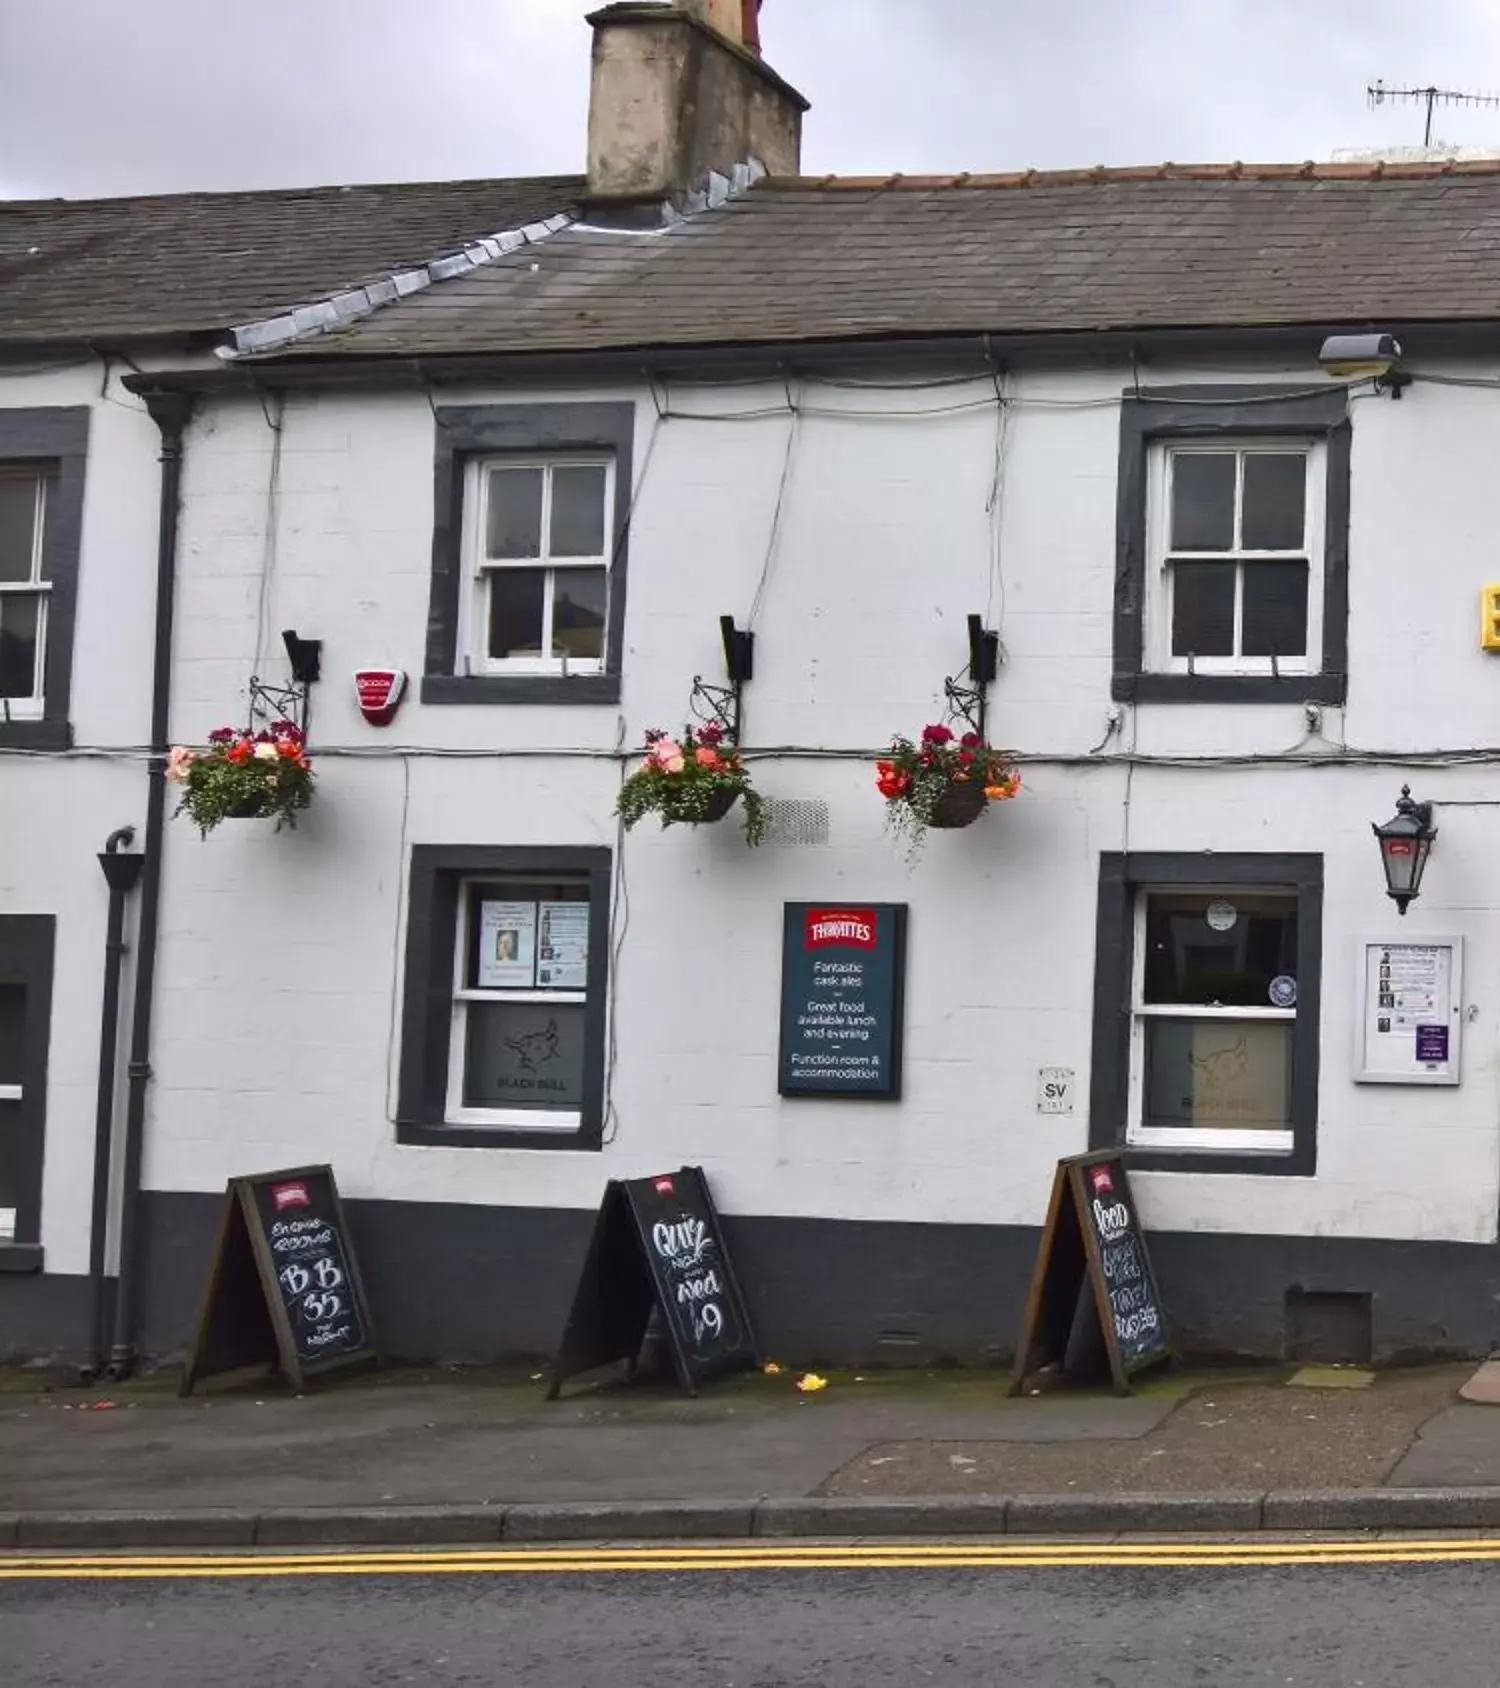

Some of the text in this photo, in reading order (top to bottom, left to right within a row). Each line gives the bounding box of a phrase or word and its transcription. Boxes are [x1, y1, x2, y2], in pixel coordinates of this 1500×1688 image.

[812, 920, 871, 941] THWAITES
[814, 961, 864, 973] Fantastic
[814, 975, 862, 987] cask ales
[808, 1001, 865, 1013] Great food
[798, 1015, 876, 1026] available lunch
[803, 1028, 869, 1041] and evening
[792, 1054, 839, 1065] Function
[840, 1056, 869, 1065] room
[792, 1067, 879, 1079] accommodation
[498, 1077, 535, 1090] BLACK
[1045, 1083, 1067, 1098] SV
